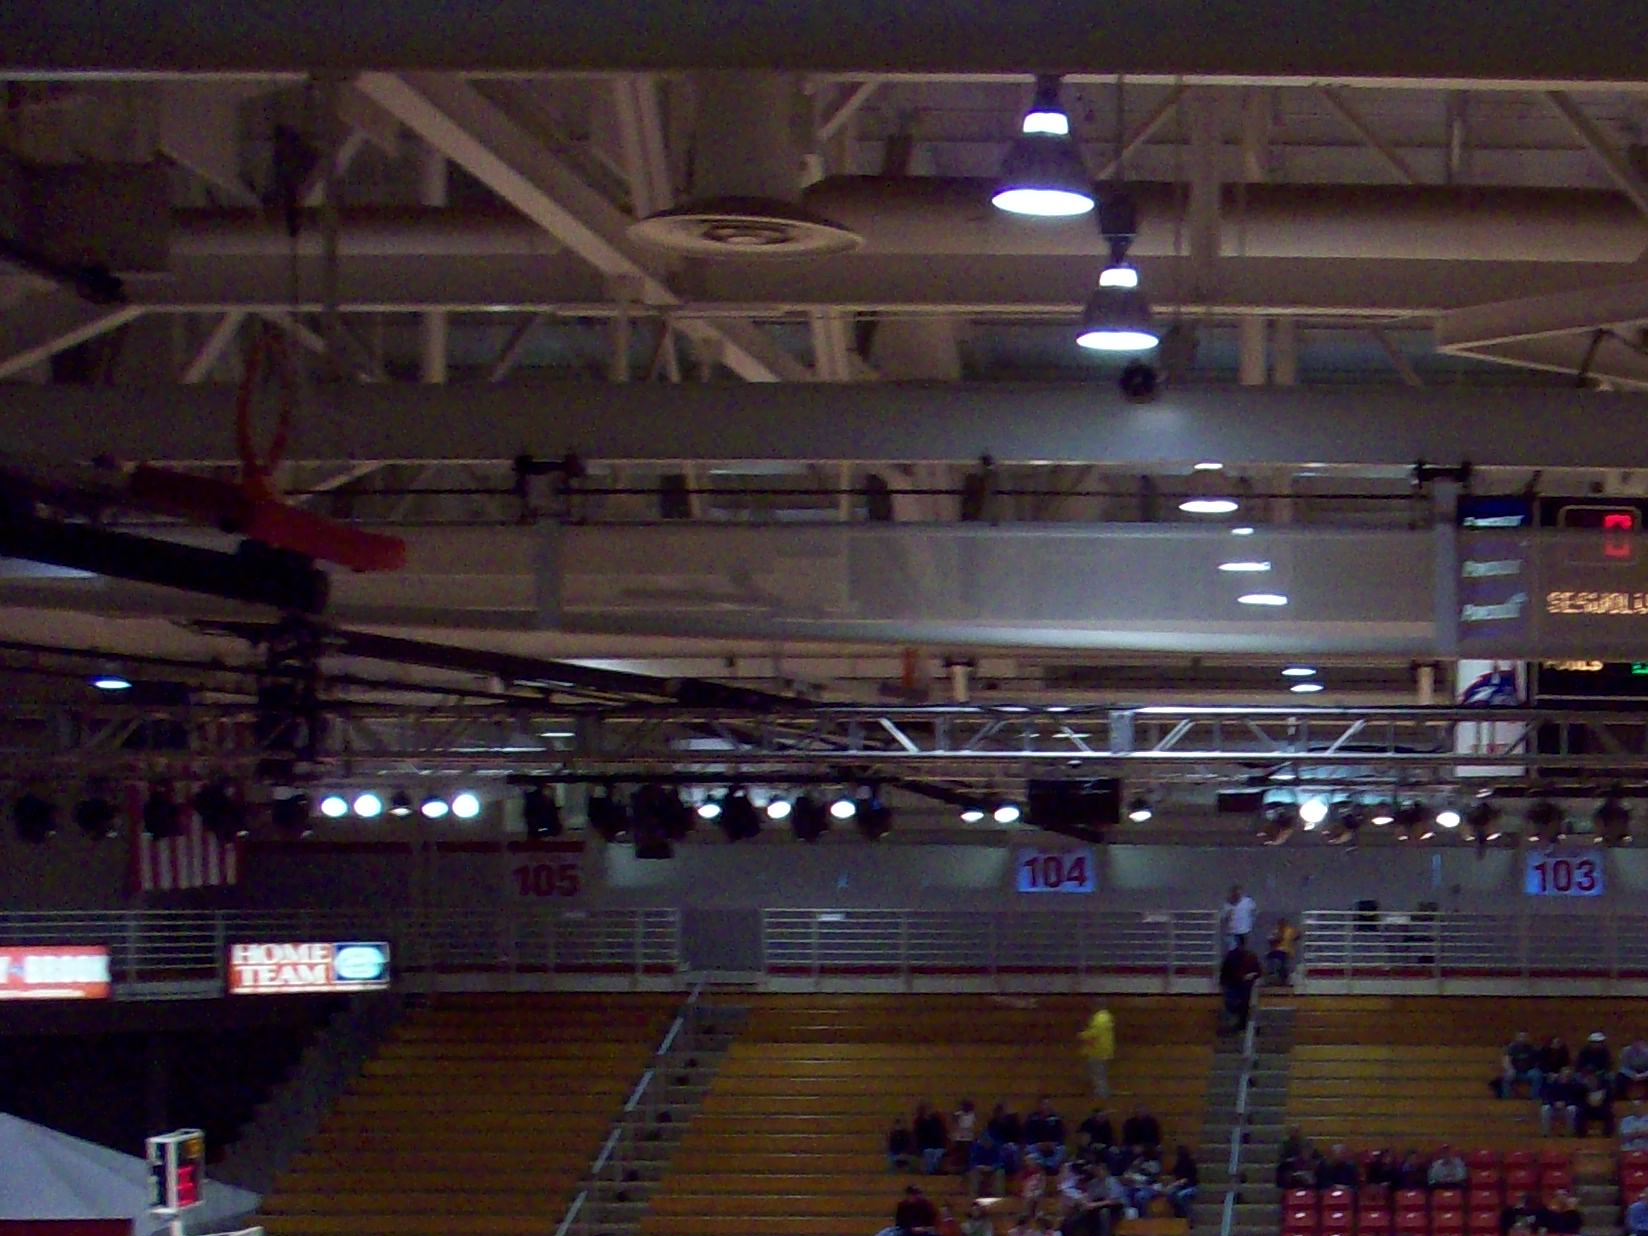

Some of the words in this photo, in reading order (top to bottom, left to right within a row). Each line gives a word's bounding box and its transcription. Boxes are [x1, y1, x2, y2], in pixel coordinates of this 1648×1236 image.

[513, 864, 579, 896] 105
[1022, 855, 1088, 887] 104
[1534, 861, 1596, 892] 103
[231, 943, 331, 963] HOME
[234, 965, 328, 985] TEAM
